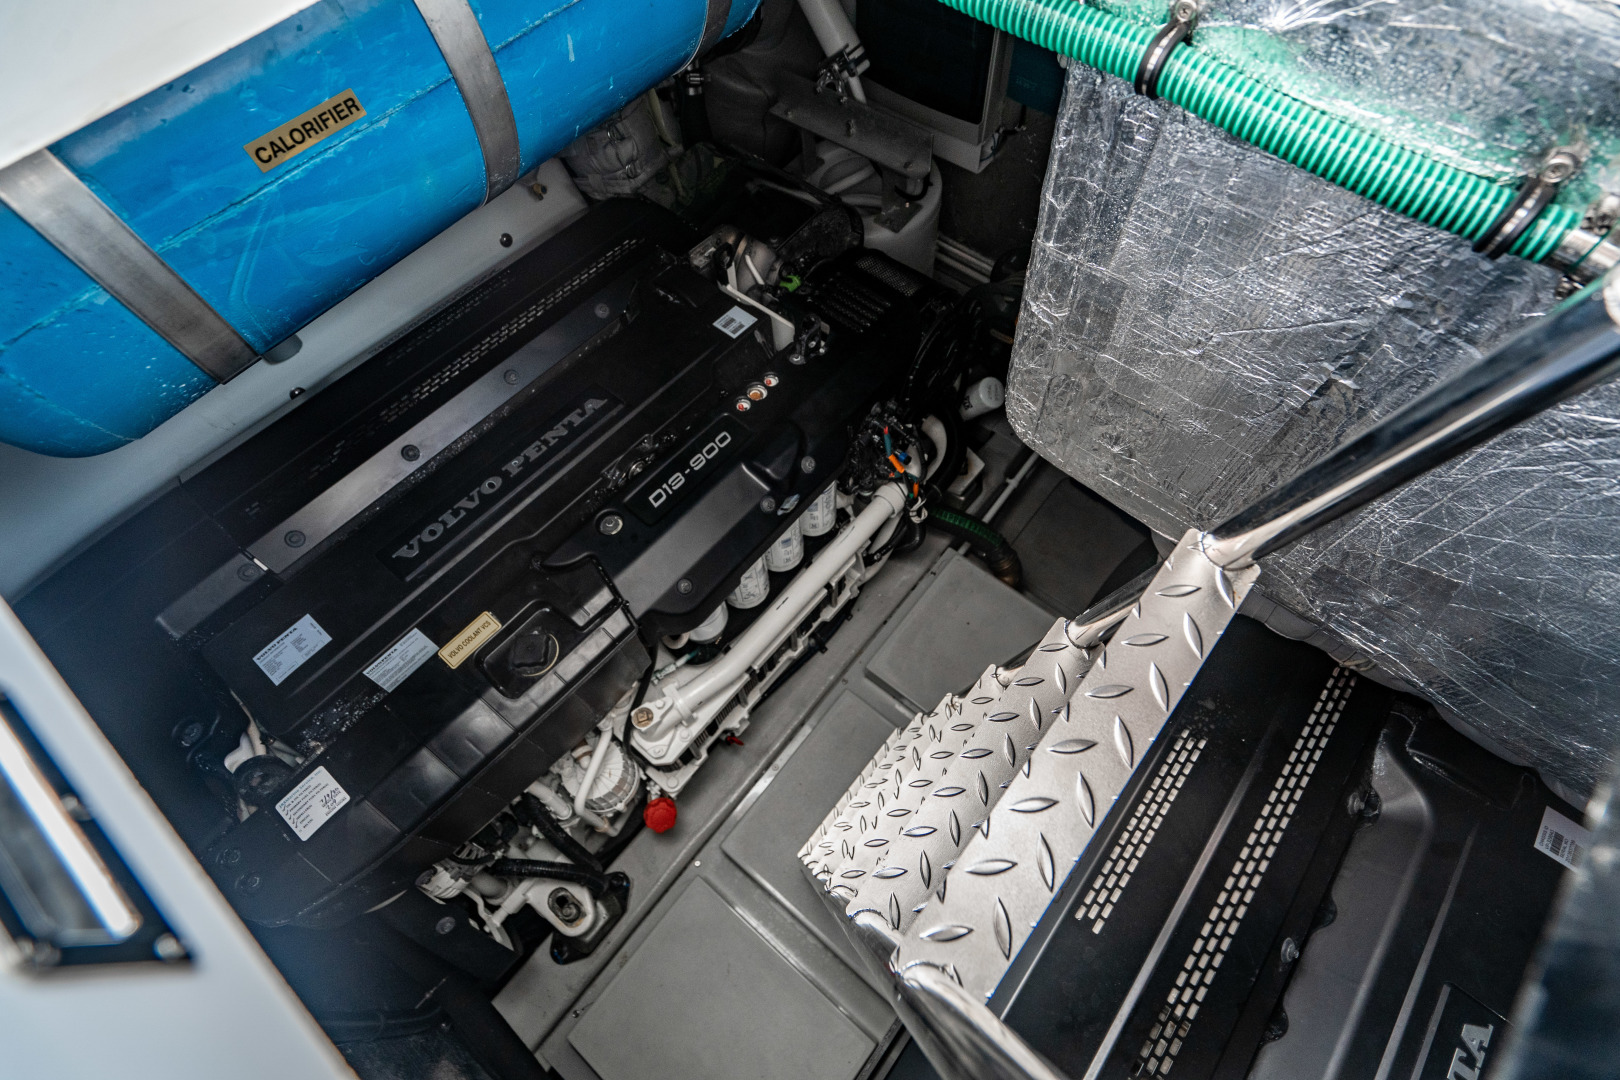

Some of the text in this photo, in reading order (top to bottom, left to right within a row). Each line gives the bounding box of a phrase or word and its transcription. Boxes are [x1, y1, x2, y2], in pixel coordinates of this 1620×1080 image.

[255, 97, 360, 164] CALORIFIER
[391, 398, 608, 558] VOLVO PENTA
[648, 431, 732, 508] D13-900
[447, 644, 464, 659] VOLVO
[462, 627, 482, 647] COOLANT
